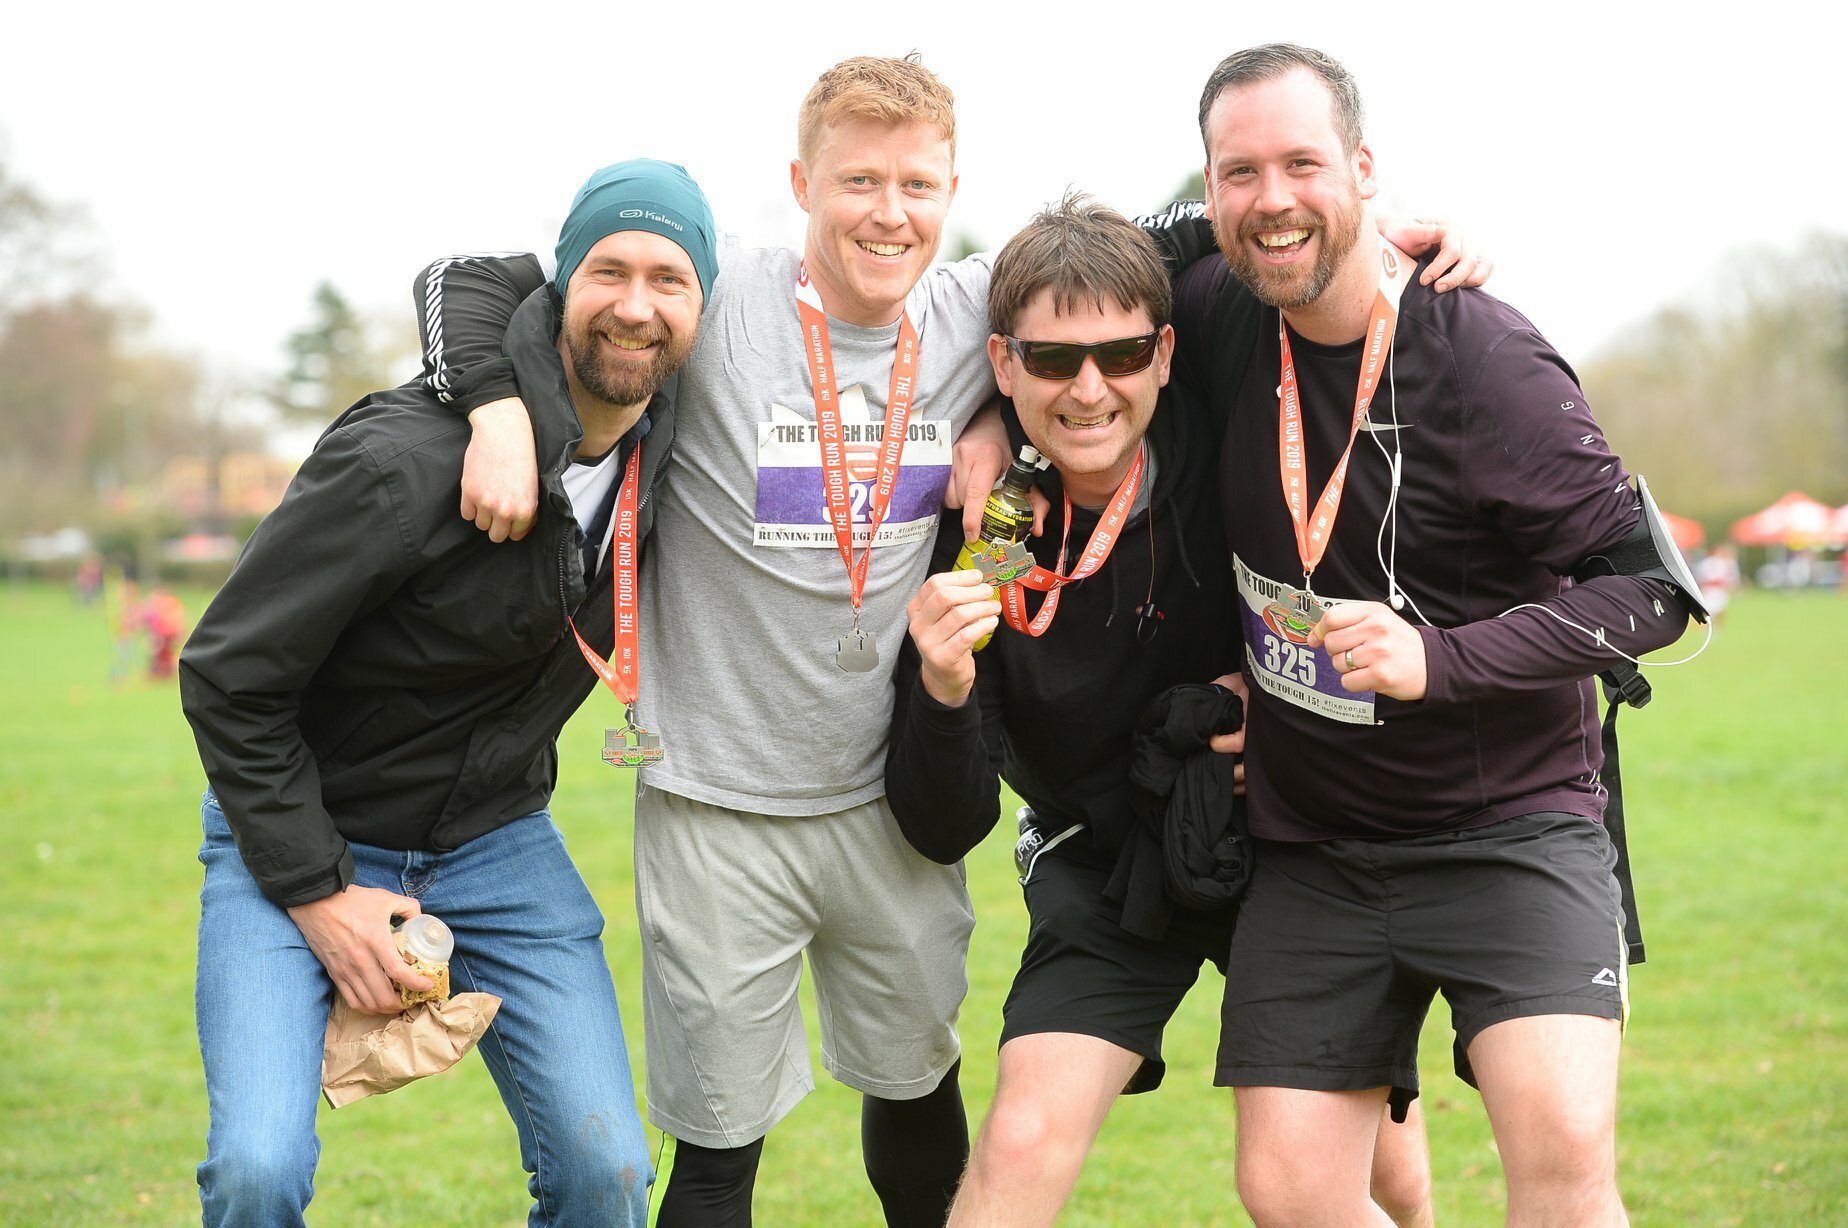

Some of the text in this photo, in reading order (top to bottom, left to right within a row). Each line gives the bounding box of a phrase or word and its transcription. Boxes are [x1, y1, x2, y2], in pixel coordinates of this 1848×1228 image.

[810, 324, 825, 364] MARATHON
[1371, 318, 1387, 355] MARATHON
[817, 366, 828, 383] HALF
[776, 425, 805, 442] THE
[808, 424, 861, 442] TGH
[1285, 362, 1301, 469] THE TOUGH RUN 2019
[880, 376, 911, 496] THE TOUGH RUN 2019
[821, 410, 848, 533] THE TOUGH RUN 2019
[1116, 494, 1128, 513] HALF
[1125, 462, 1141, 497] MARATHON
[1324, 483, 1340, 508] THE
[758, 531, 810, 541] RUNNING
[813, 532, 836, 542] THE
[1079, 555, 1100, 573] RUN
[1090, 531, 1112, 557] 2019
[619, 510, 633, 634] THE TOUGH RUN 2019
[1031, 609, 1052, 630] 2019
[623, 647, 631, 675] 5K 10K
[1264, 634, 1317, 687] 325
[1261, 674, 1320, 707] THE TOUGH 15!
